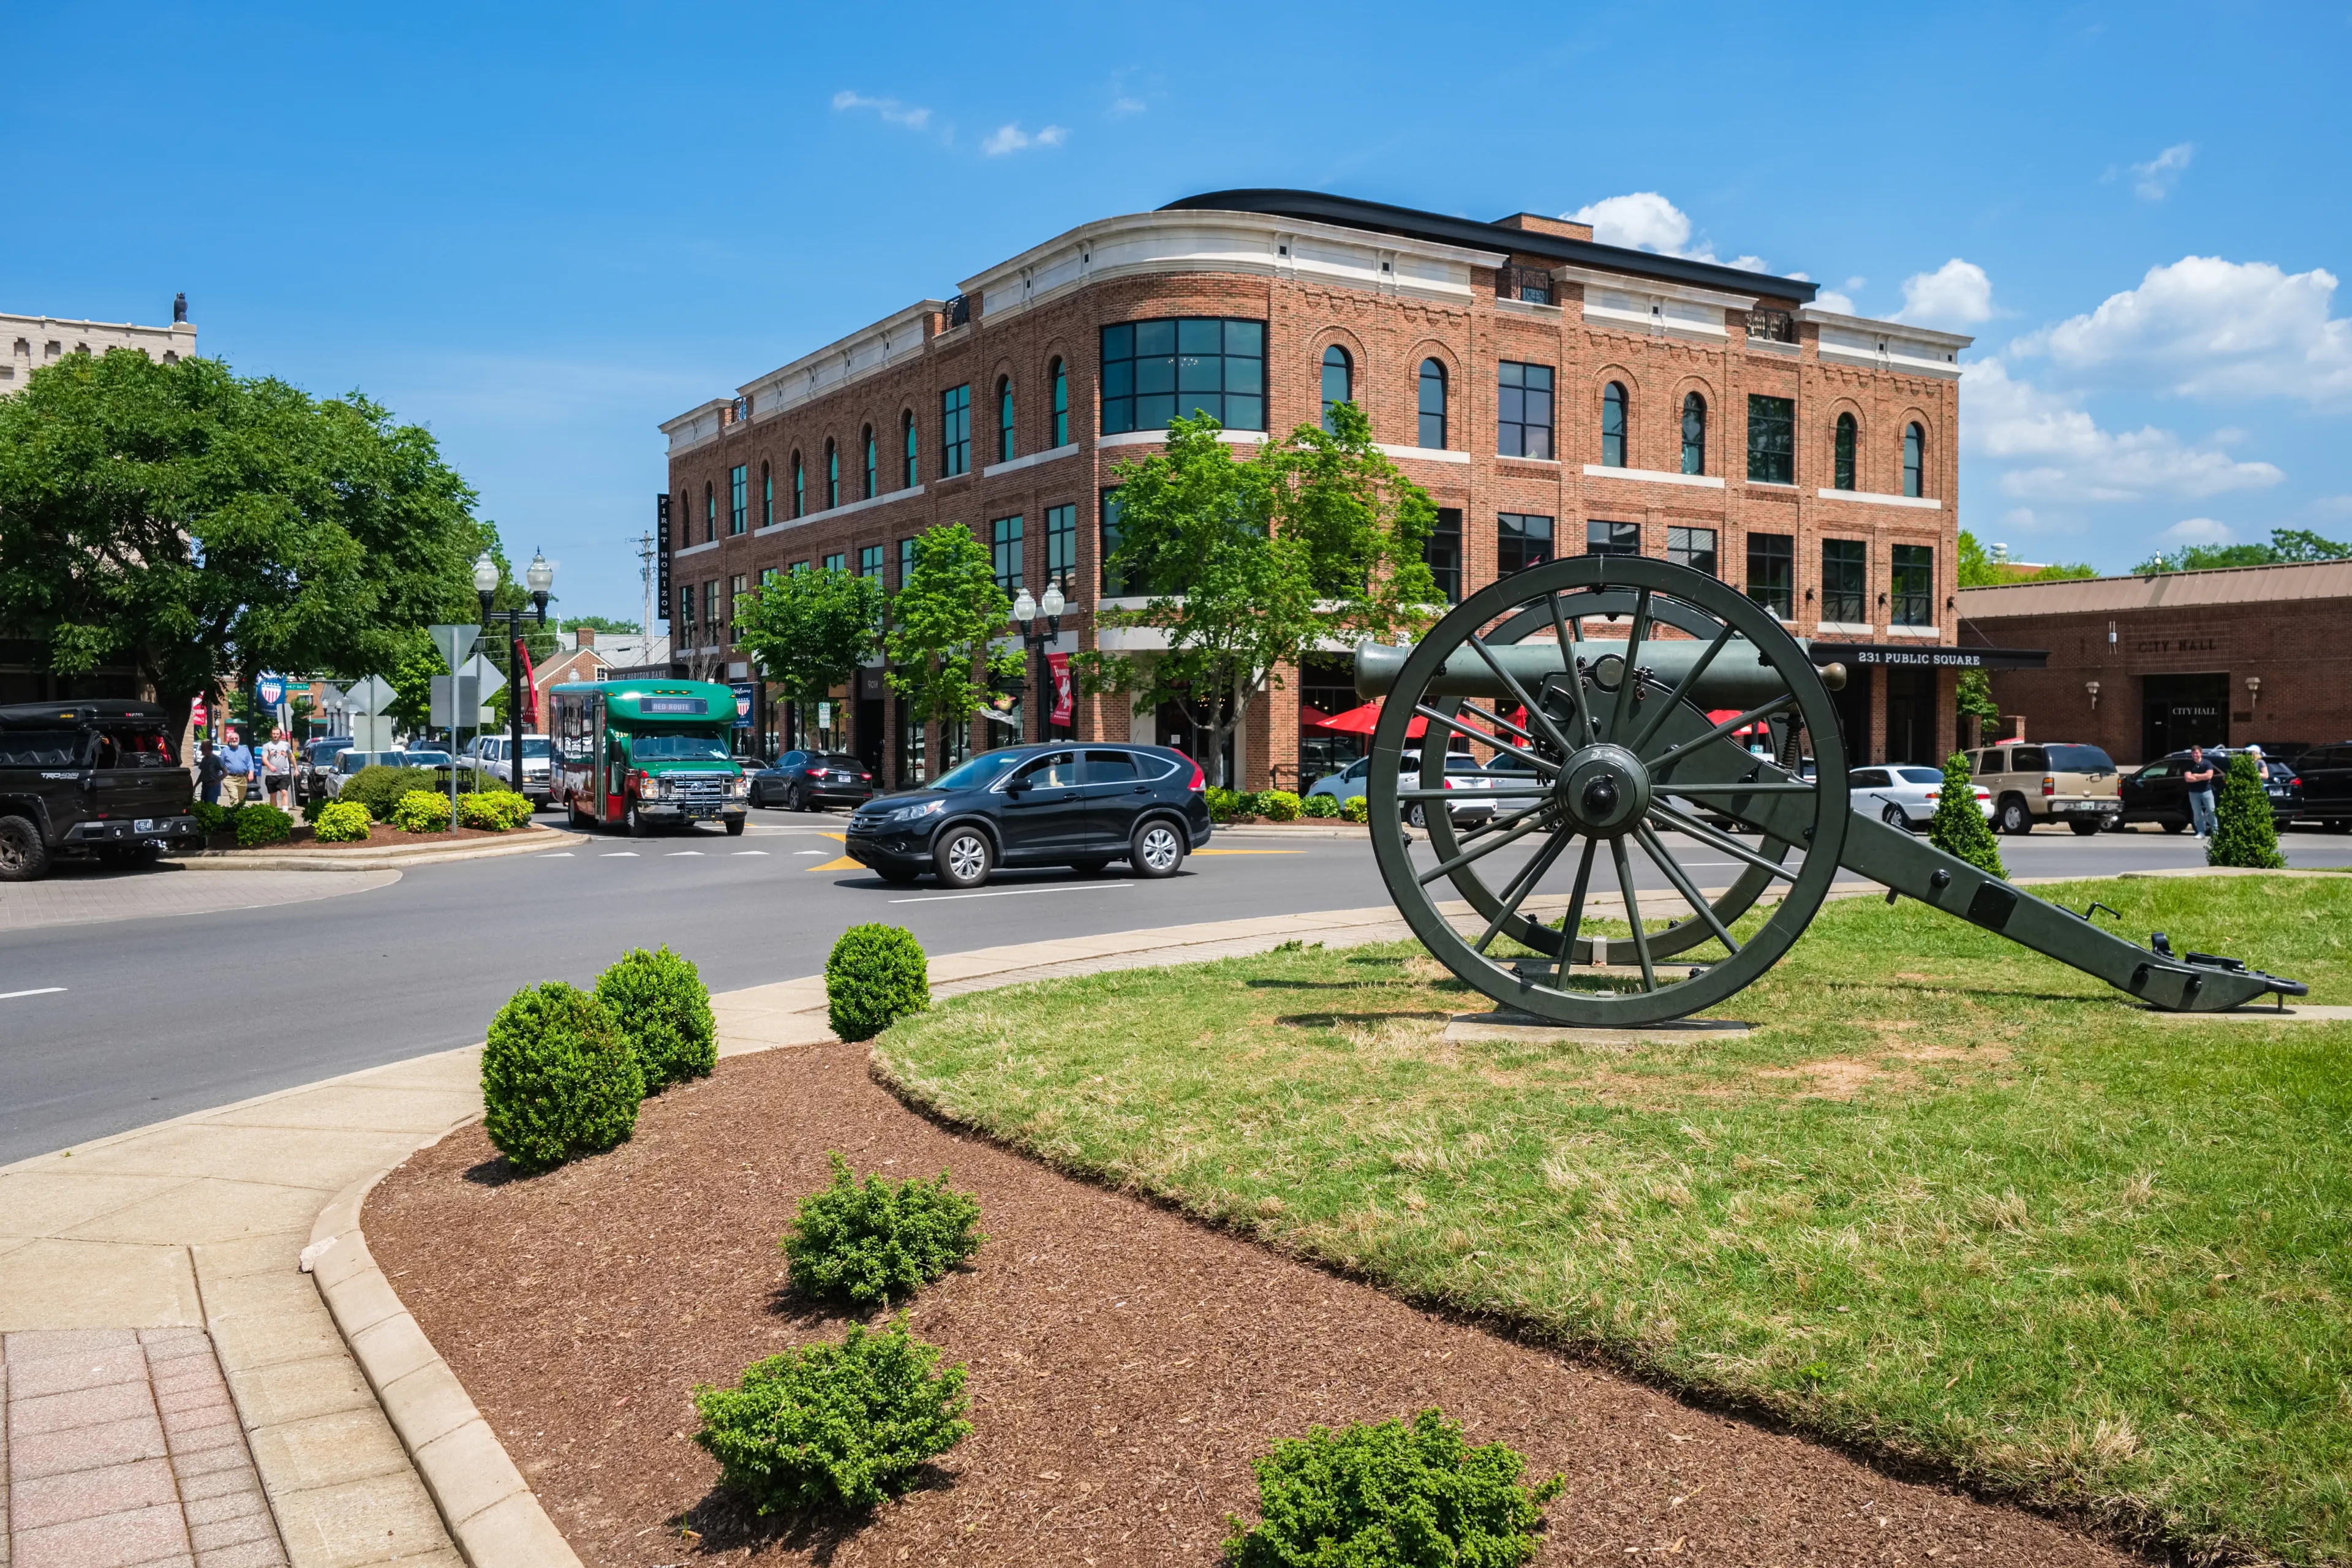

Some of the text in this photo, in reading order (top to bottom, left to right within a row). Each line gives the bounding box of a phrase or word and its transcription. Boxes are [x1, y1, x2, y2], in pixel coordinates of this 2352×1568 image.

[2178, 638, 2217, 652] HALL
[1858, 652, 1980, 666] 231 PUBLIC SQUARE
[627, 672, 649, 680] HORIZON
[2194, 707, 2218, 715] HALL
